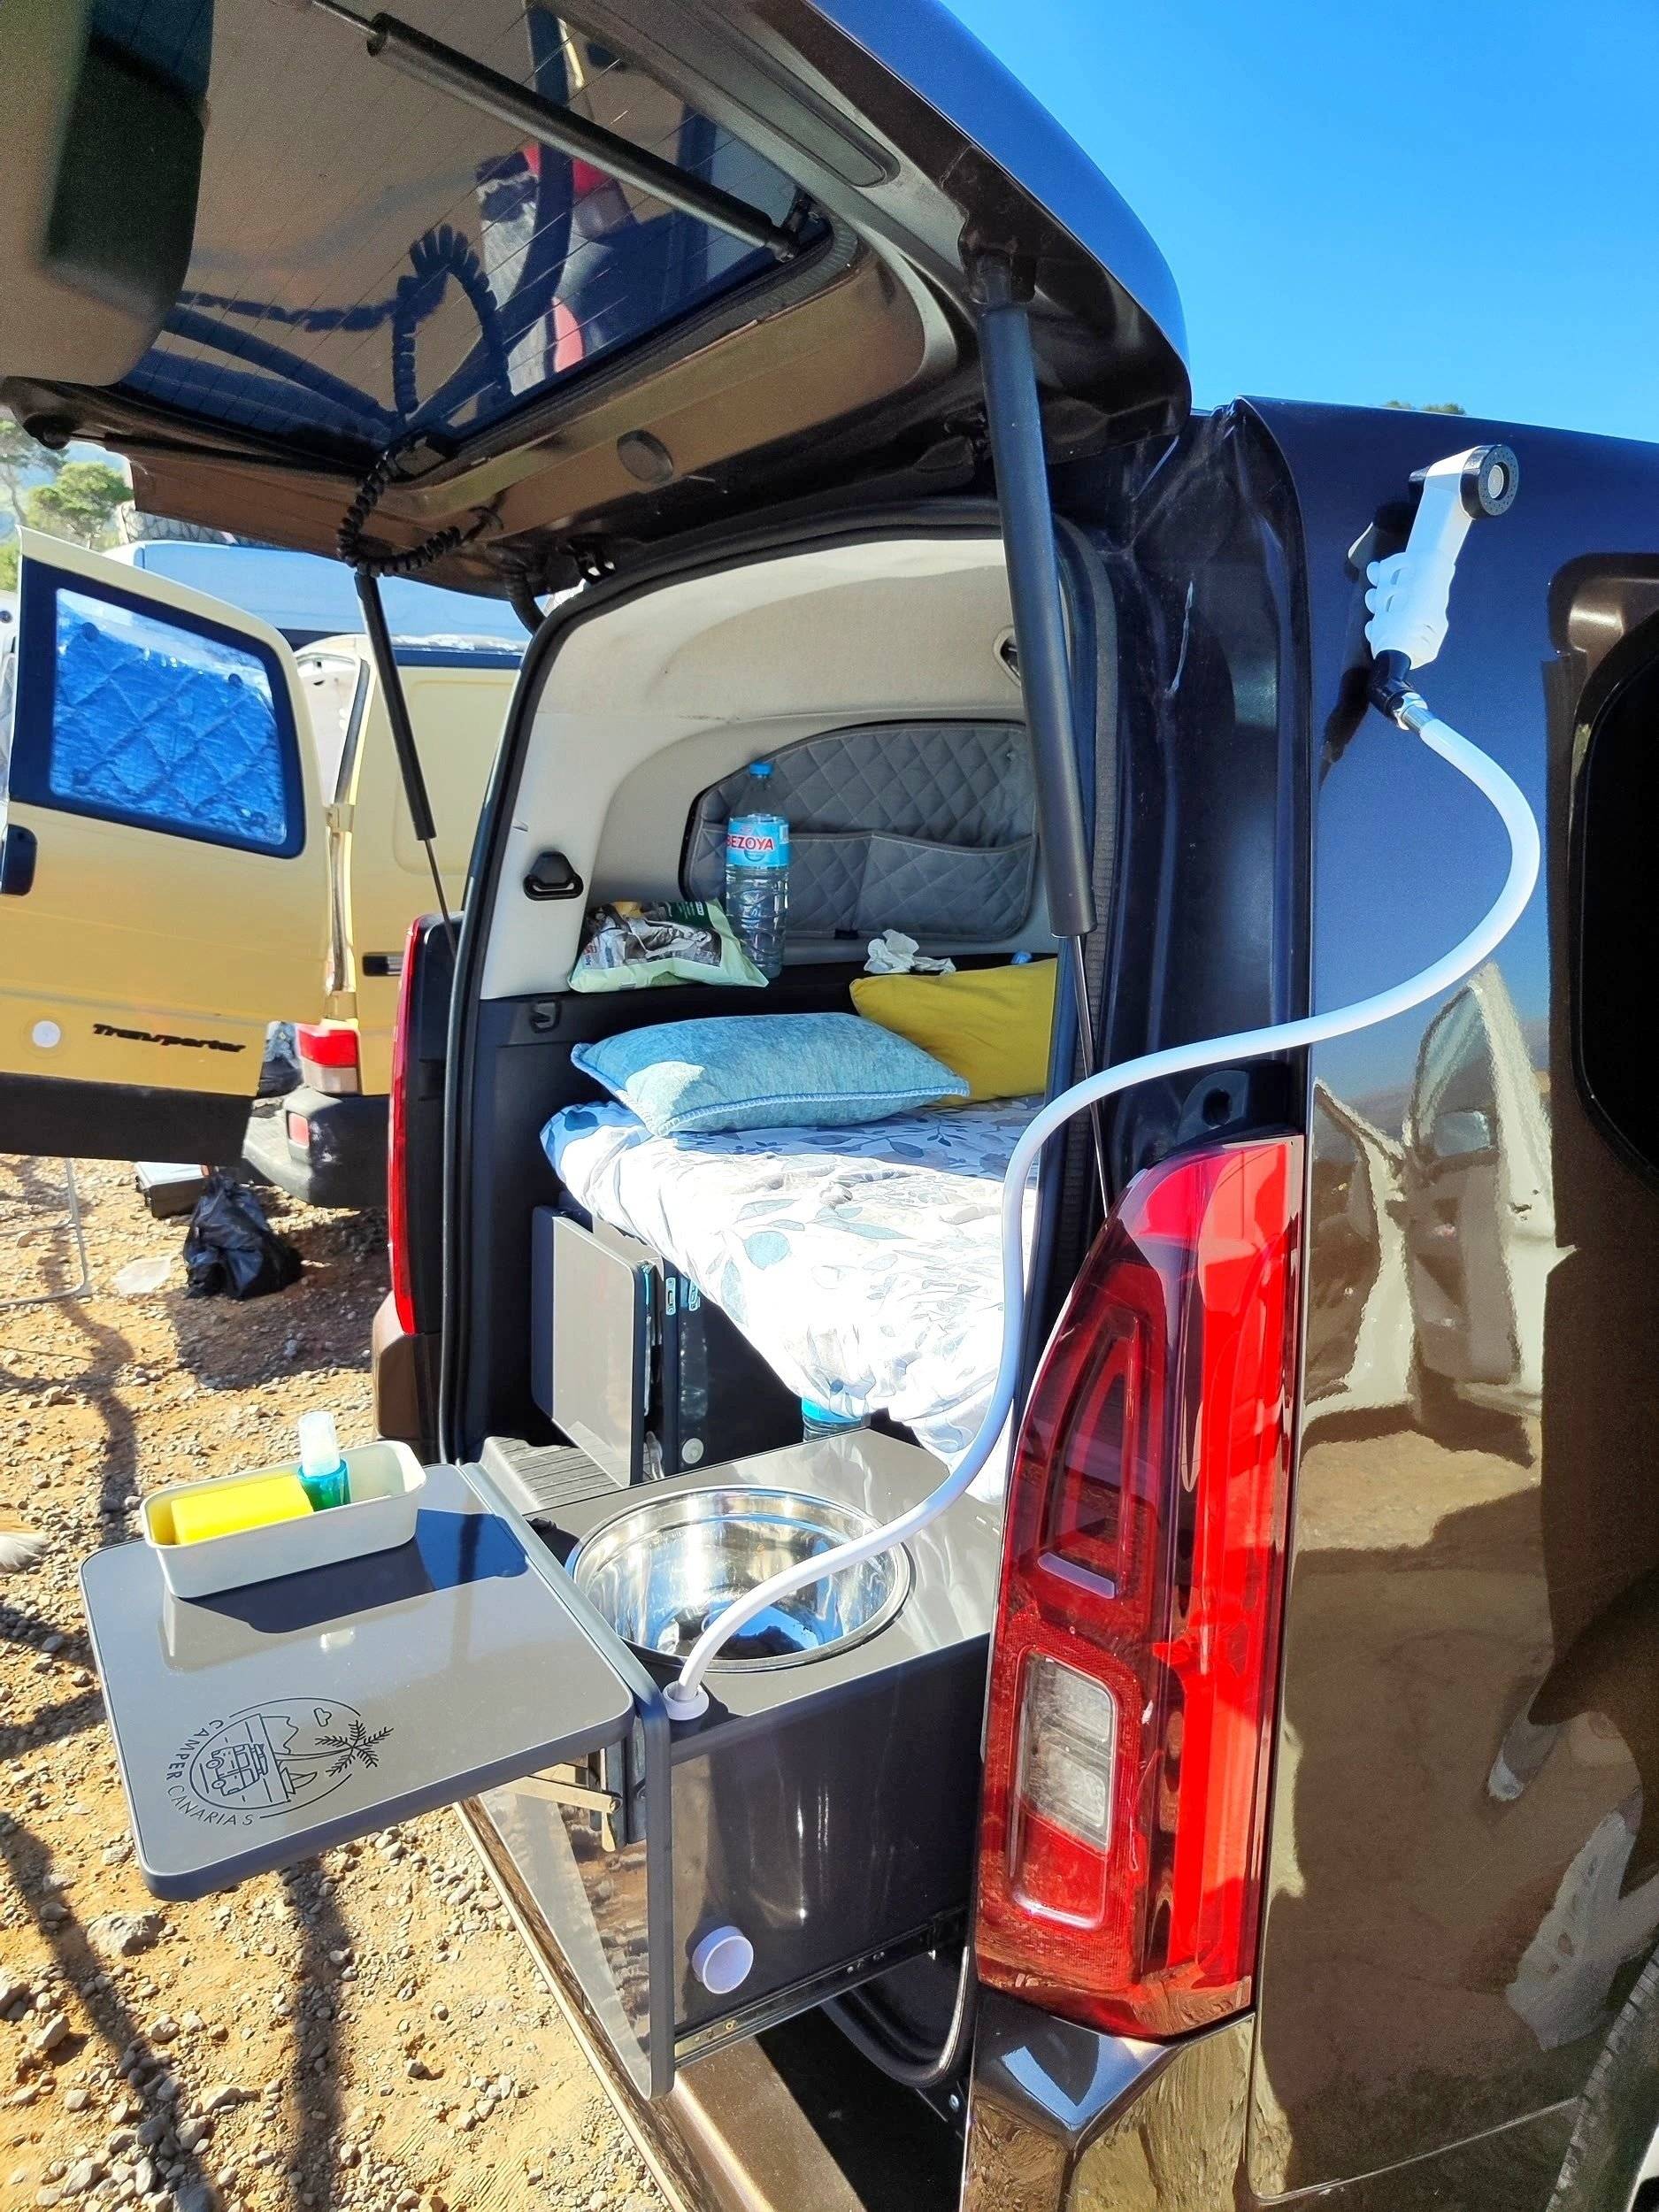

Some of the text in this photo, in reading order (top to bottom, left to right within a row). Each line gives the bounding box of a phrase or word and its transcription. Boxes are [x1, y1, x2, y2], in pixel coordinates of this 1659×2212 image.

[93, 1024, 246, 1052] Transporter
[166, 1720, 254, 1825] CAMPER CANARIAS
